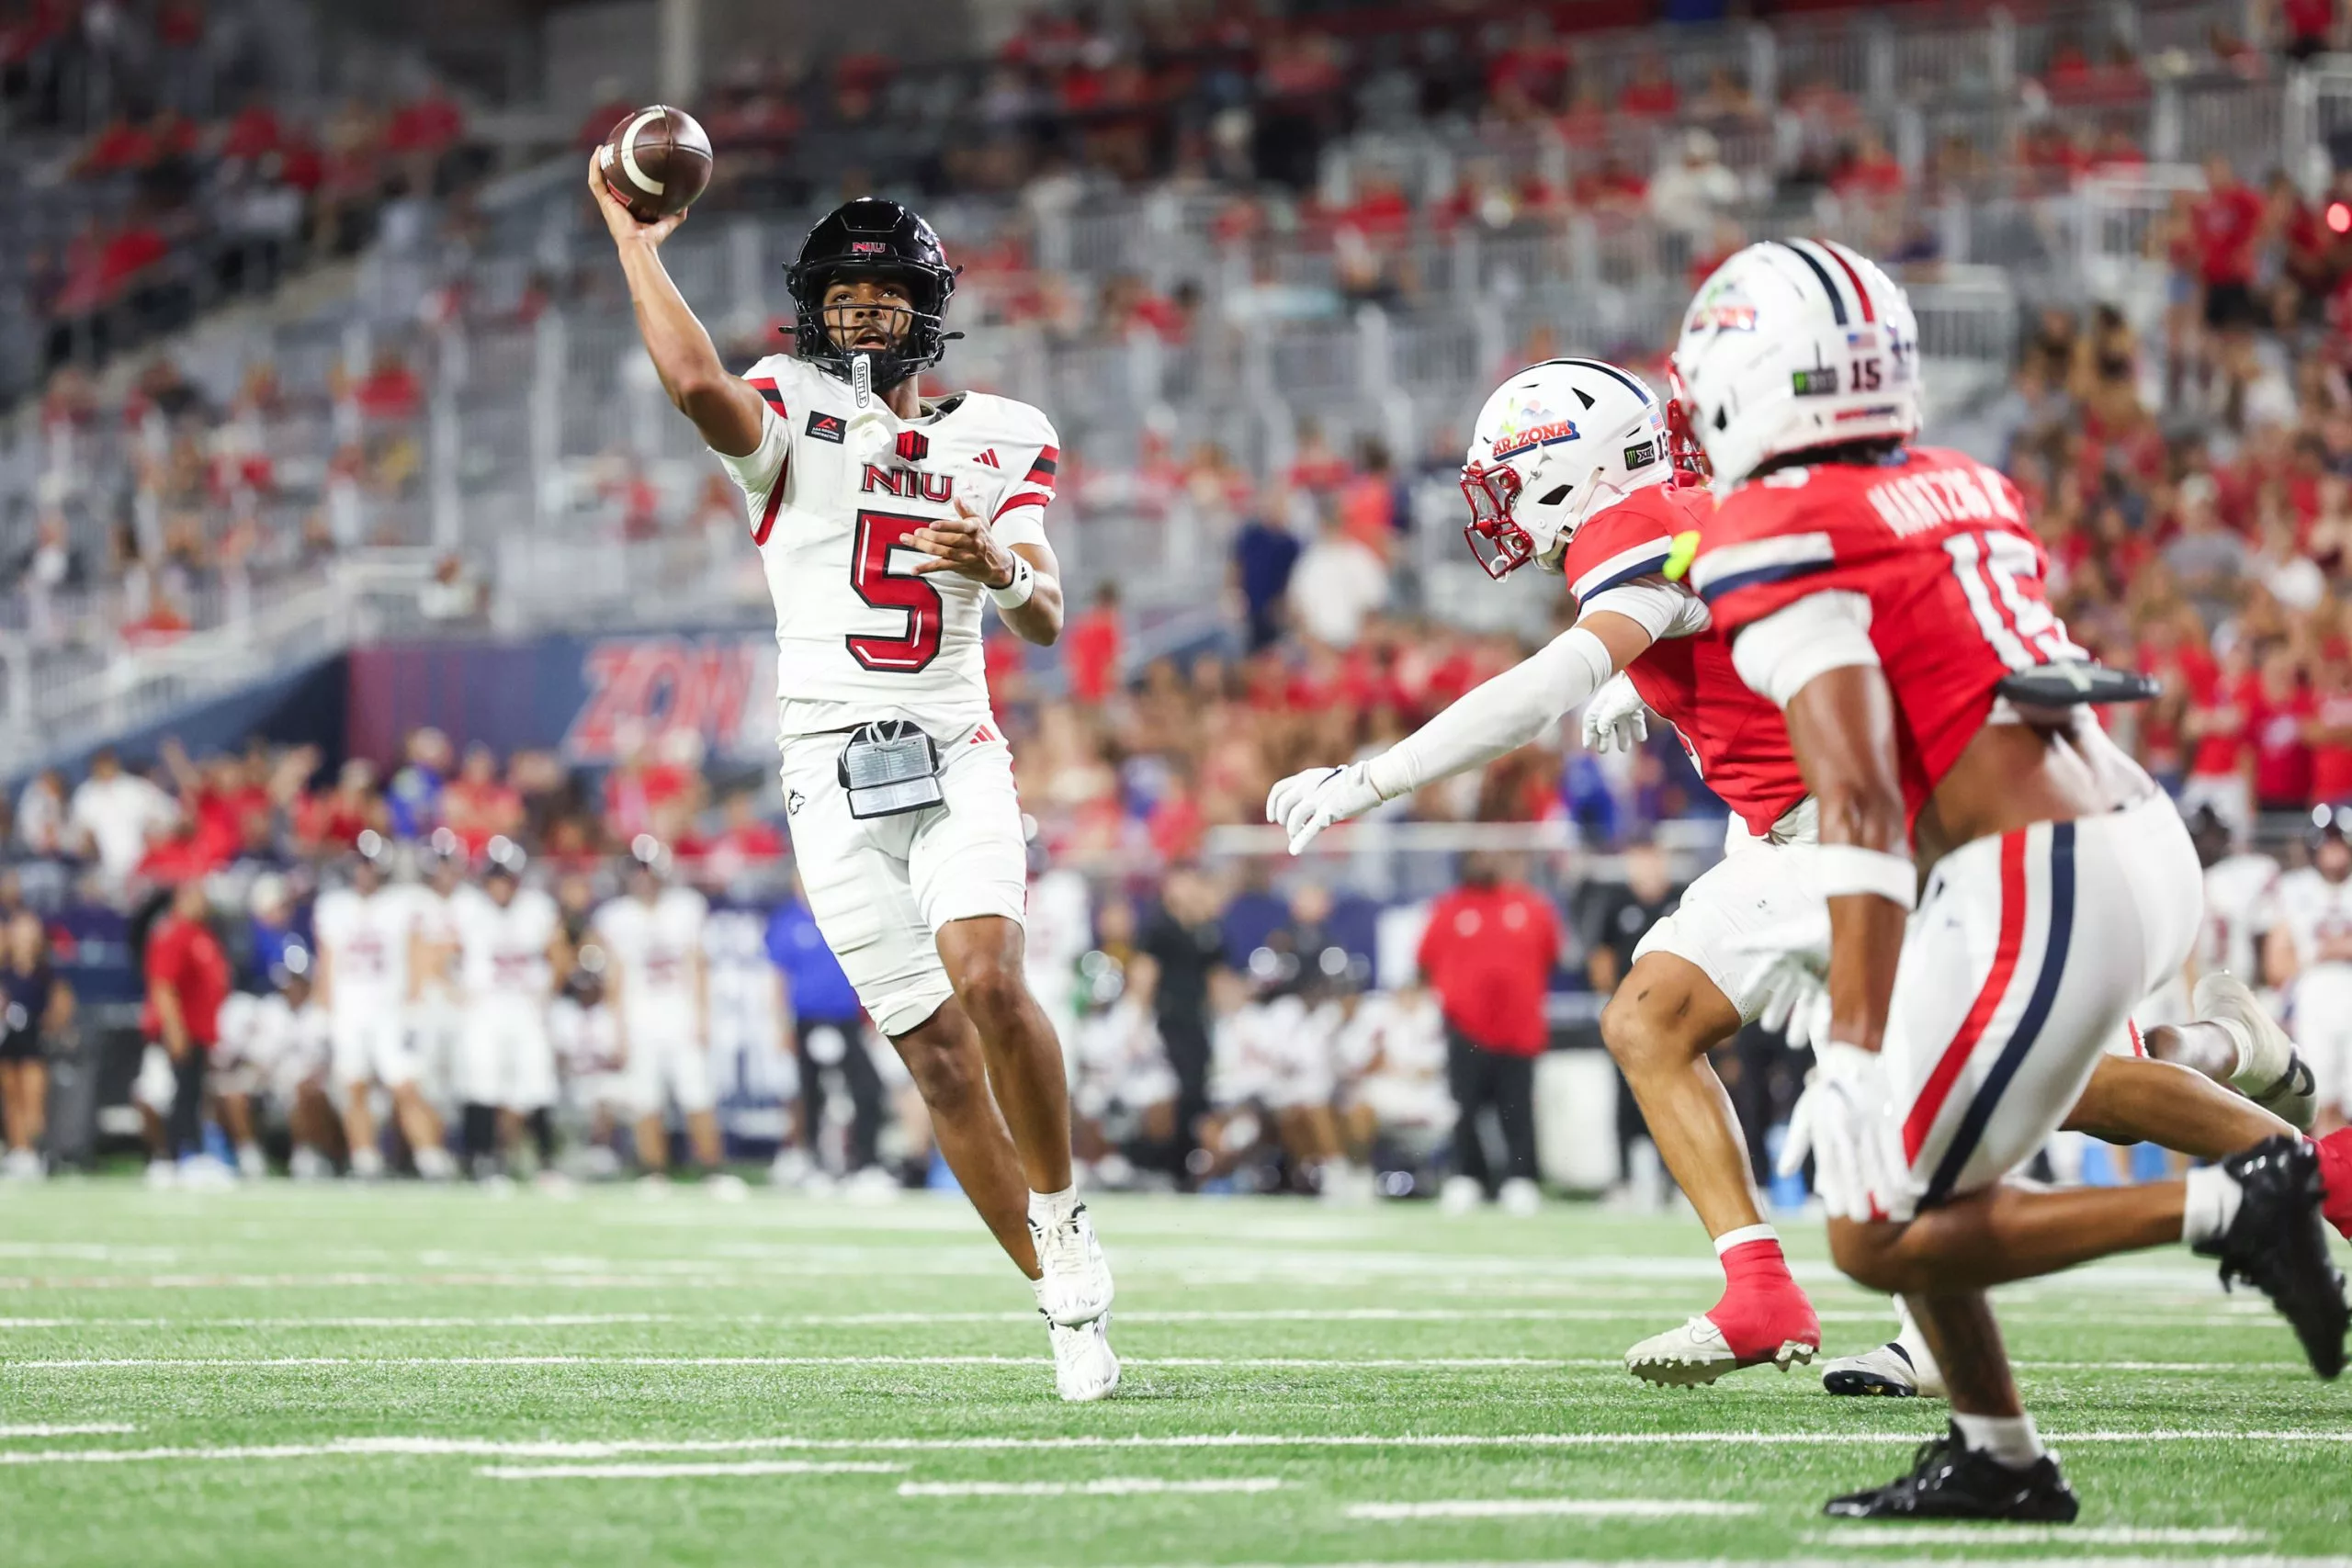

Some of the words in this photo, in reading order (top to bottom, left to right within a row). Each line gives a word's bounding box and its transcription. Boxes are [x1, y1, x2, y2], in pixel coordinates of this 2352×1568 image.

[852, 242, 886, 254] NIU
[856, 366, 867, 404] BATTLE
[1850, 357, 1882, 392] 15
[861, 464, 954, 503] NIU
[845, 508, 950, 674] 5
[1941, 529, 2090, 673] 15
